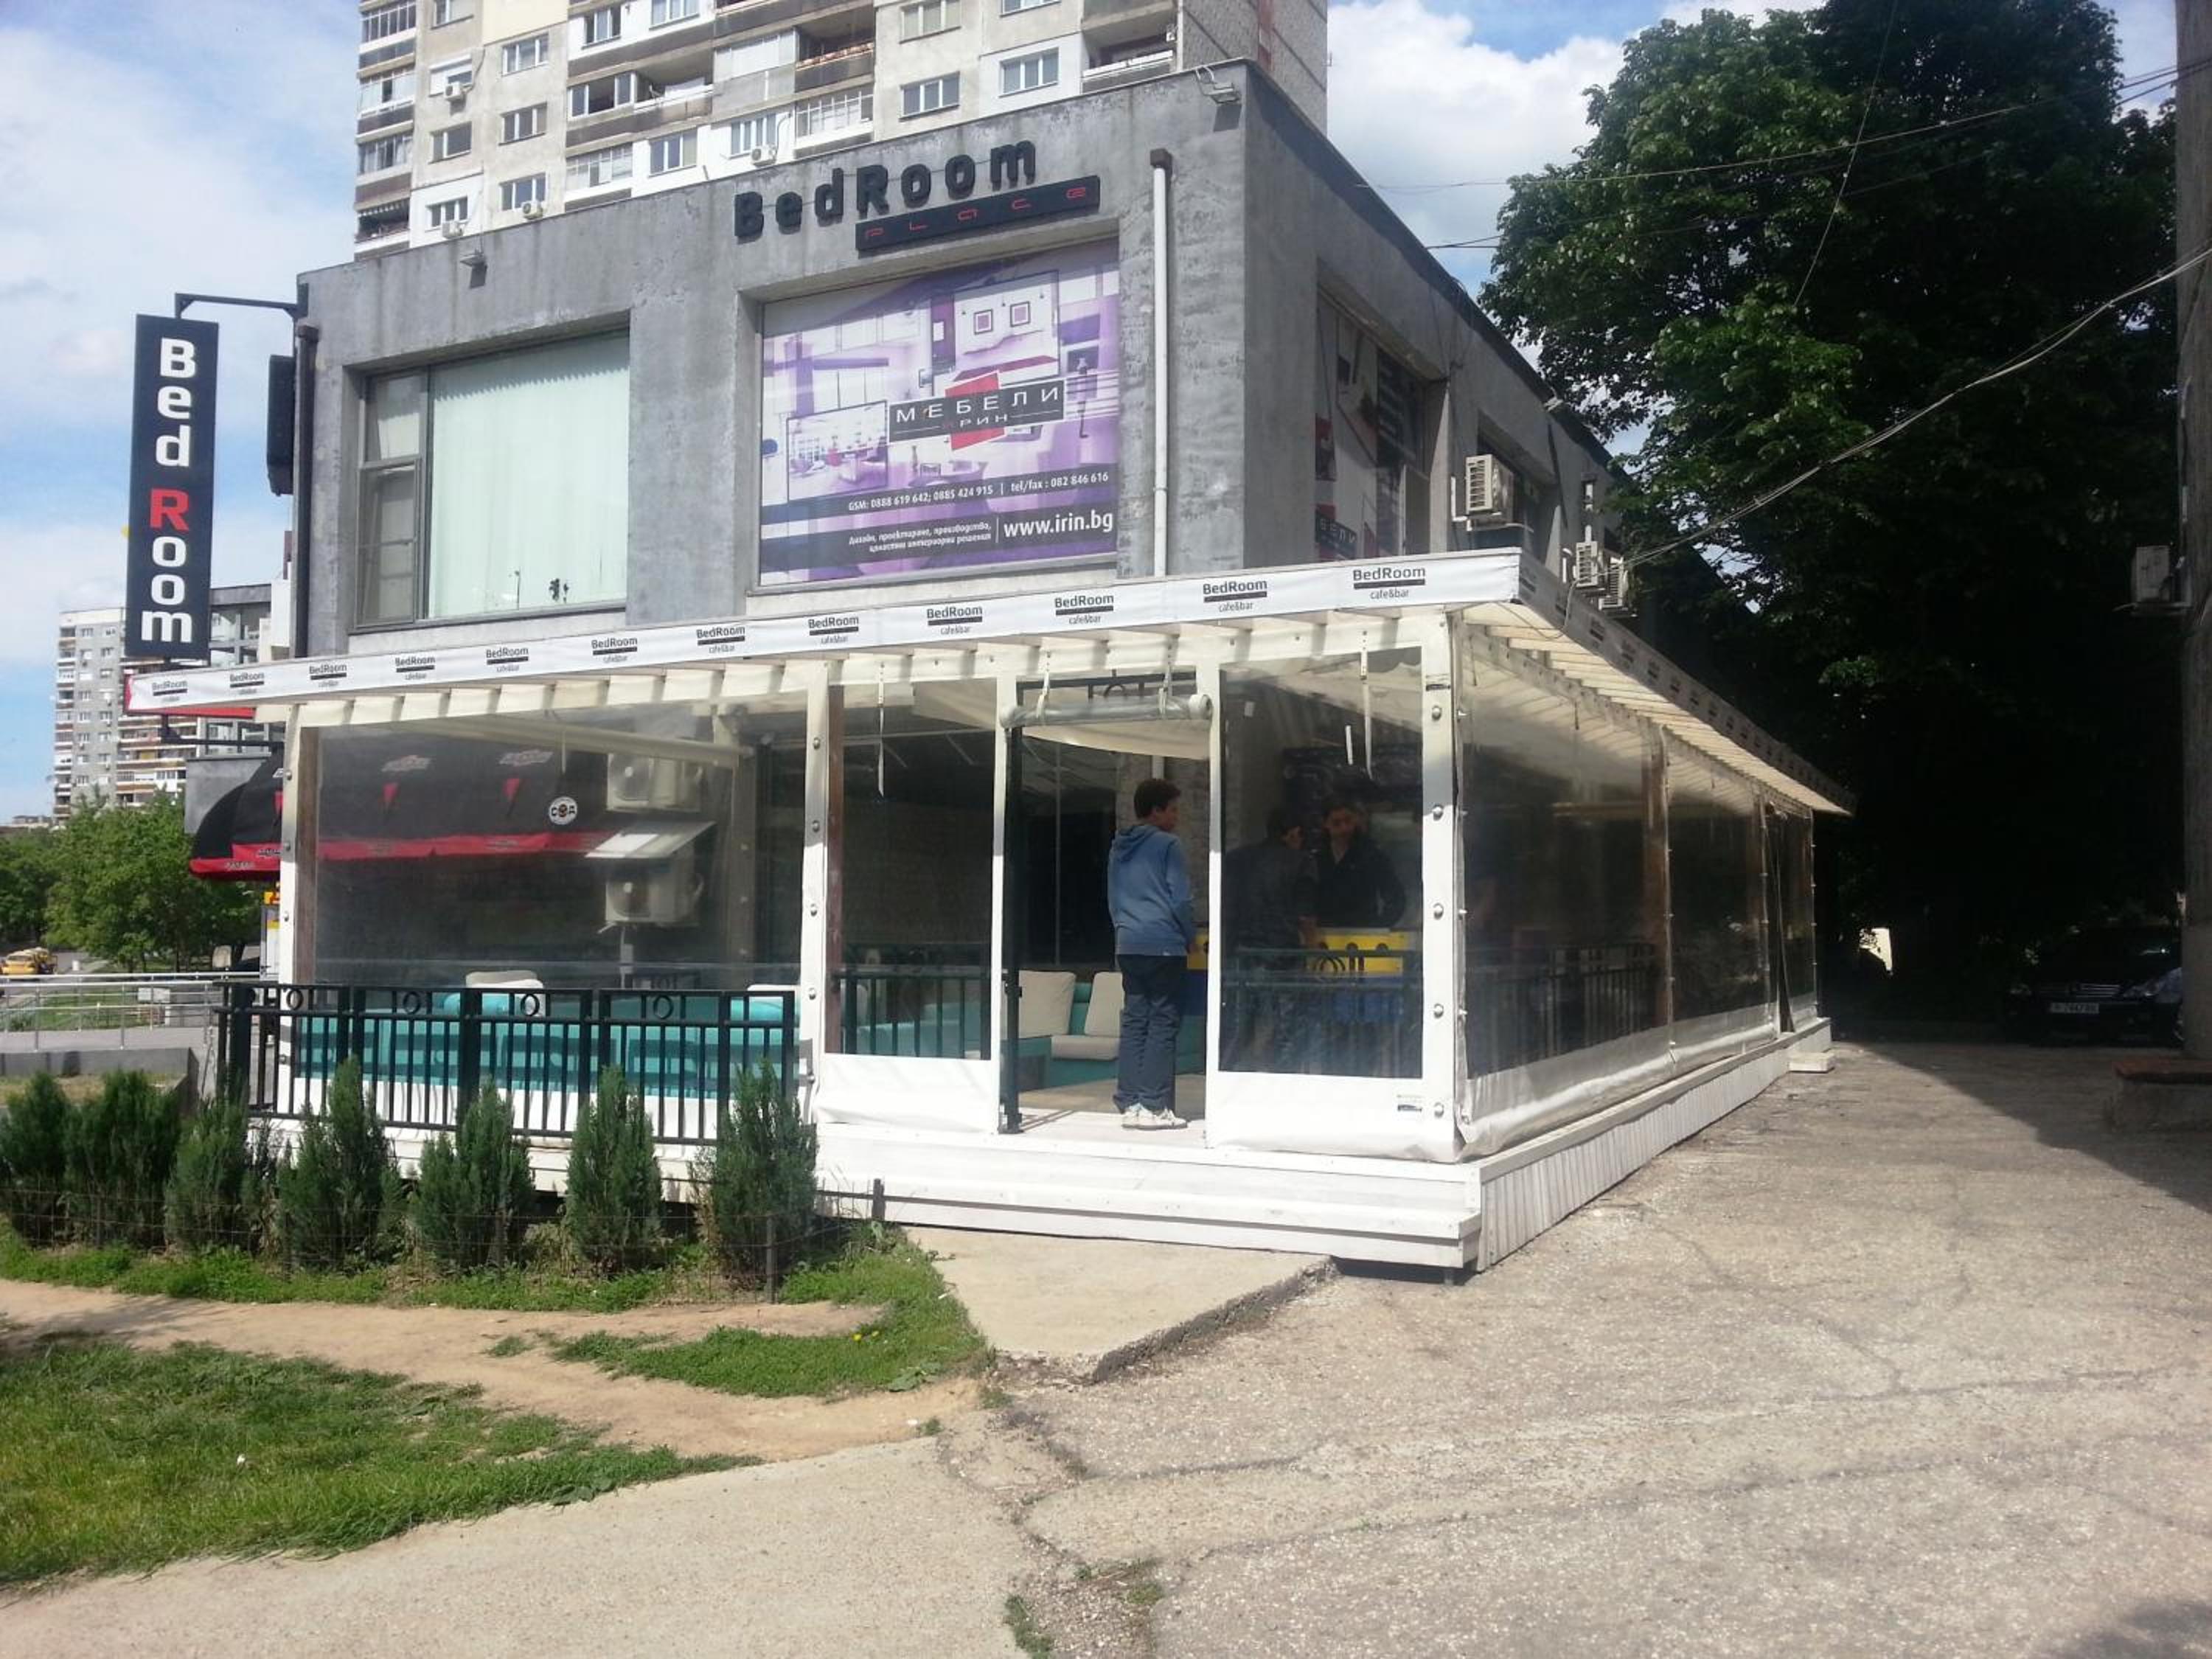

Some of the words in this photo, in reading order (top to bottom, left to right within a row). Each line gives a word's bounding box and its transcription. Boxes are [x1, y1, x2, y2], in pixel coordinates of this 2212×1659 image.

[734, 140, 1036, 240] BedRoom
[156, 338, 196, 467] Bed
[896, 387, 1059, 423] МЕБЕЛИ
[945, 414, 1008, 429] РИН
[894, 495, 911, 506] 619
[958, 487, 974, 498] 424
[976, 484, 993, 495] 915
[1051, 476, 1068, 487] 082
[1091, 472, 1109, 483] 616
[1004, 509, 1113, 538] www.irin.bg
[141, 488, 193, 644] Room
[1353, 566, 1426, 580] BedRoom
[1203, 580, 1267, 595] BedRoom
[1370, 588, 1410, 599] cafe&bar
[1054, 594, 1114, 608] BedRoom
[927, 606, 982, 619] BedRoom
[808, 616, 859, 629] BedRoom
[697, 626, 745, 639] BedRoom
[591, 637, 638, 650] BedRoom
[486, 647, 529, 658] BedRoom
